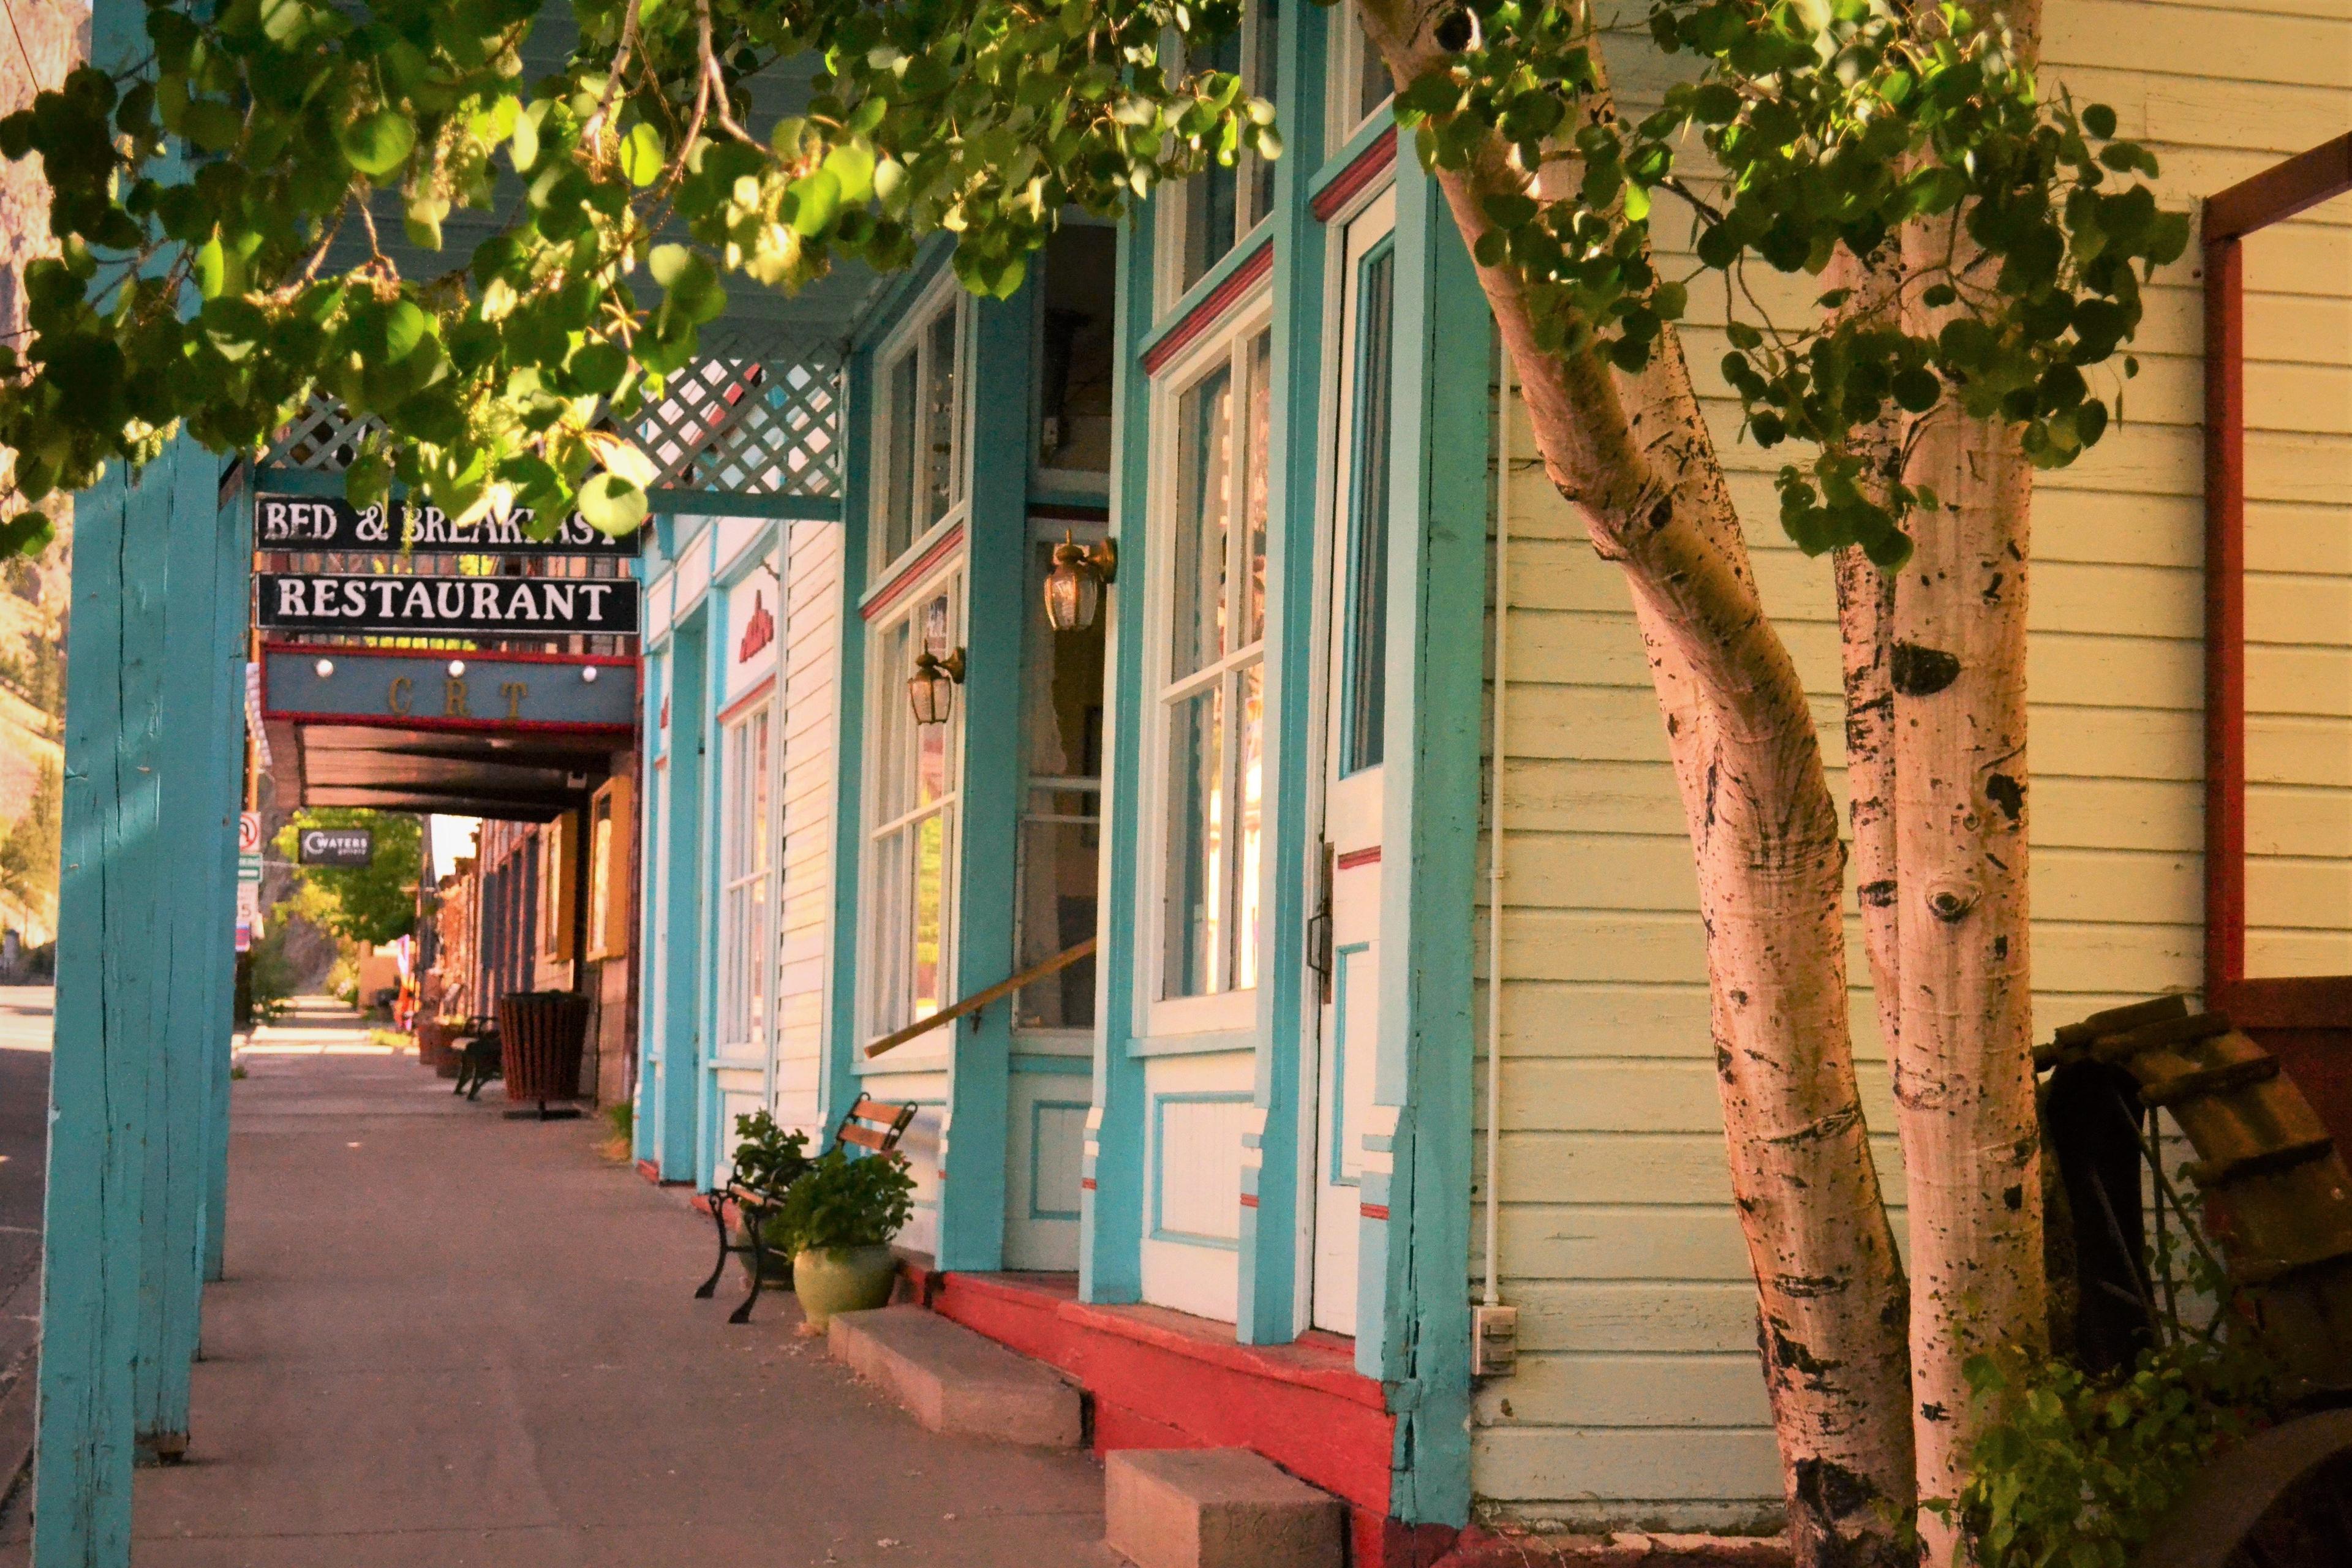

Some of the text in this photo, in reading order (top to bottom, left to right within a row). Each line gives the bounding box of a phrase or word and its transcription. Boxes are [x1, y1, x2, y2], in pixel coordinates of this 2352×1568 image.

[265, 503, 337, 540] BED
[355, 501, 389, 541] &
[277, 579, 611, 620] RESTAURANT
